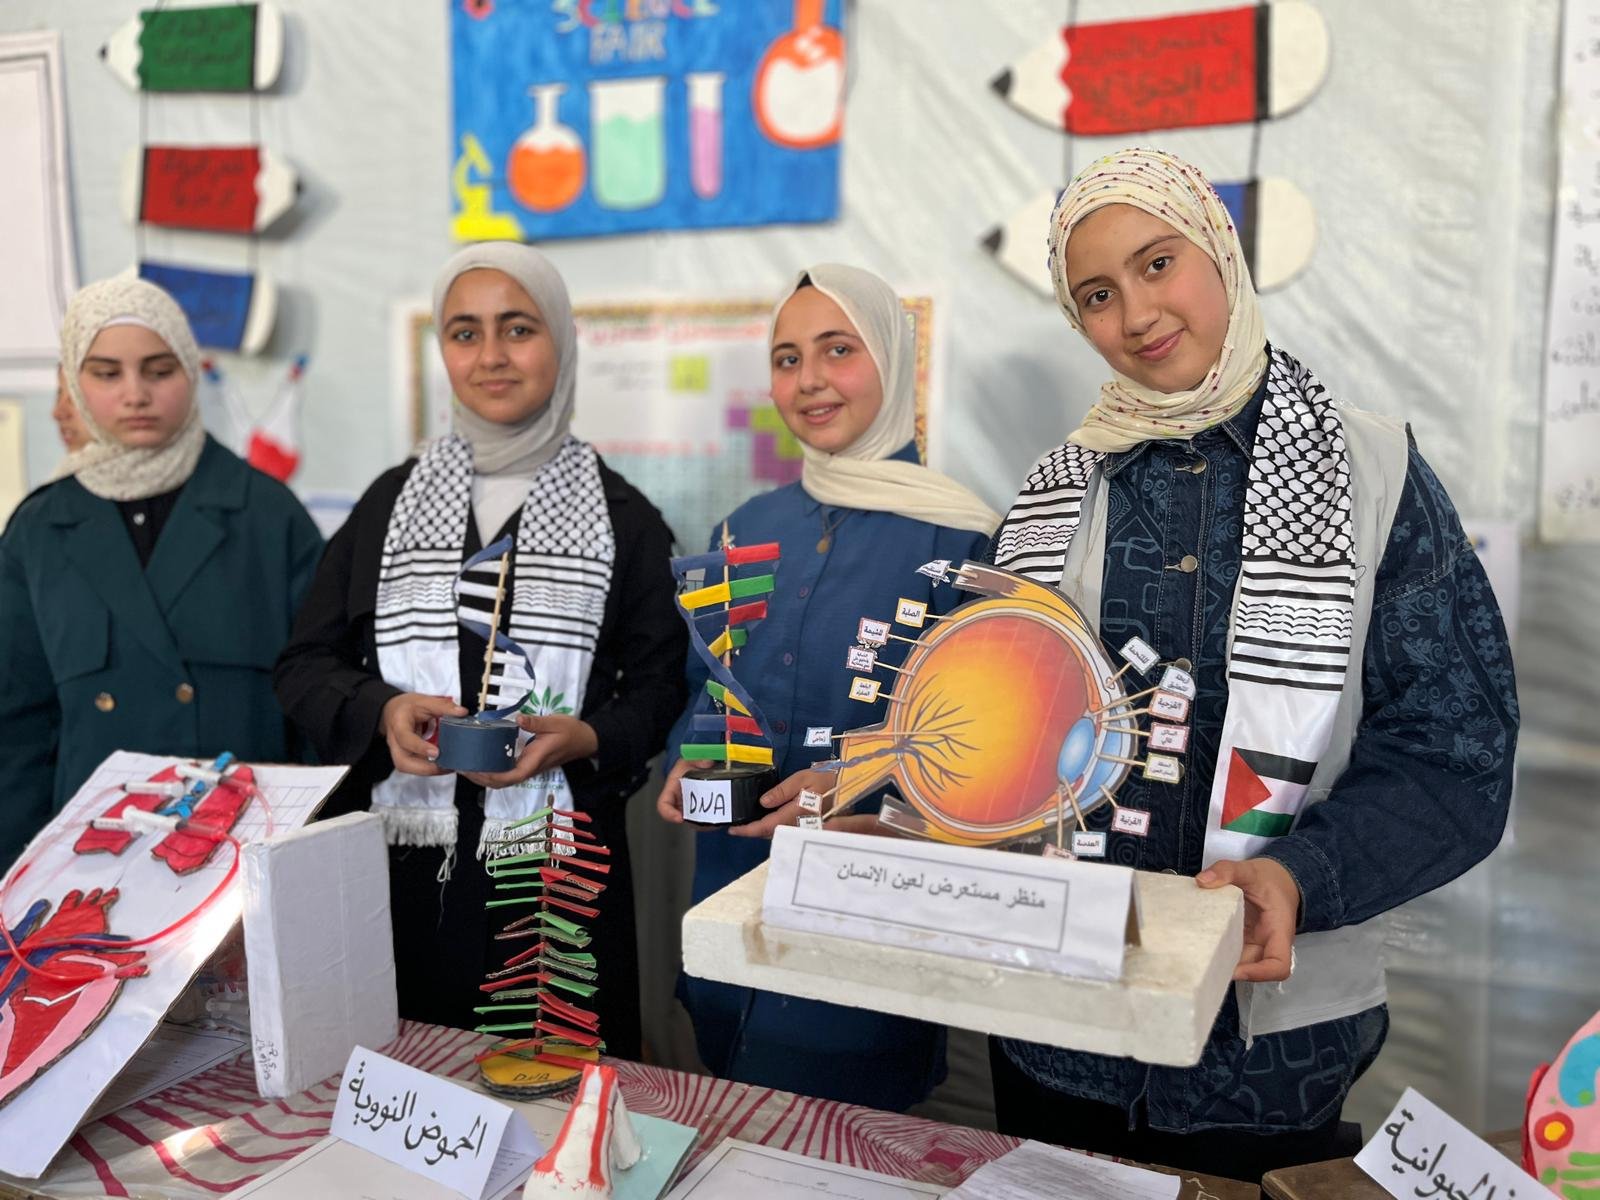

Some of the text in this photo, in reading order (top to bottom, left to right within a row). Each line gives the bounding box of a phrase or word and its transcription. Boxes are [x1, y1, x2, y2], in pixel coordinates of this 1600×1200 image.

[689, 791, 725, 816] DNA
[1120, 814, 1142, 826] القرنية
[836, 862, 1046, 909] منظر مستعرض لعين الإنسان
[512, 1073, 550, 1081] DNA
[348, 1060, 417, 1132] النووية
[403, 1110, 488, 1166] الحموض
